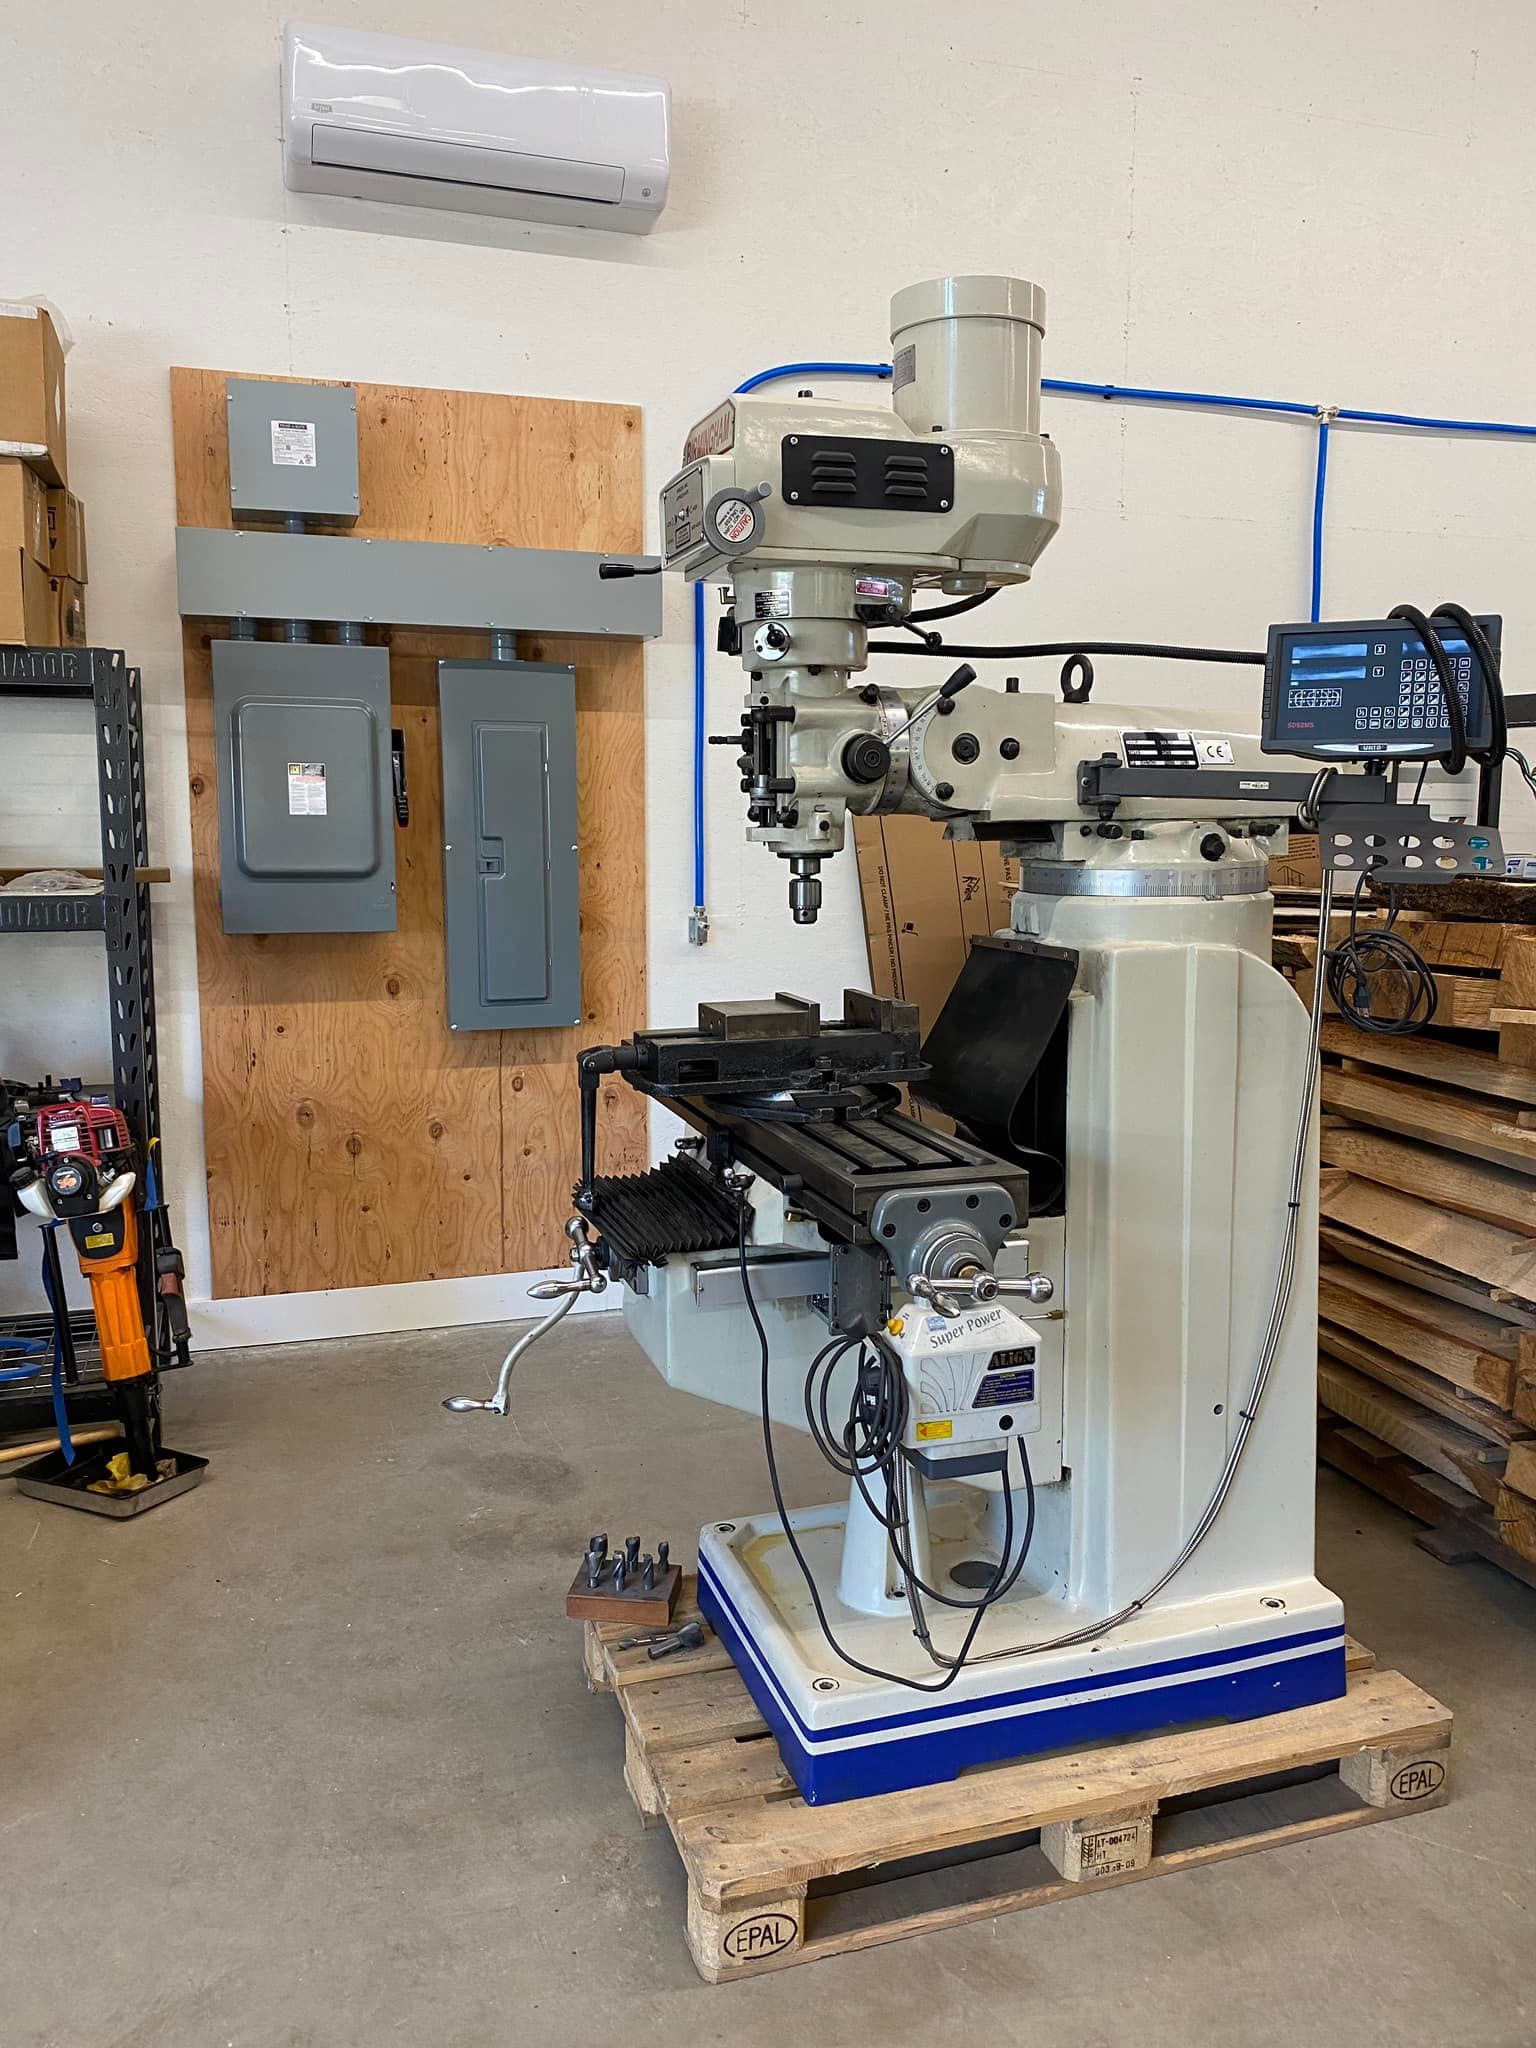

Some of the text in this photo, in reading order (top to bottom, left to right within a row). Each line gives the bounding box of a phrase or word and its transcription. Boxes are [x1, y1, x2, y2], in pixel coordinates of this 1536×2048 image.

[732, 514, 741, 524] NOT
[738, 507, 746, 515] DO
[730, 514, 752, 541] CAUTION
[930, 1324, 964, 1349] Super
[967, 1309, 1001, 1332] Power
[1400, 1768, 1436, 1794] EPAL
[737, 1922, 786, 1953] EPAL
